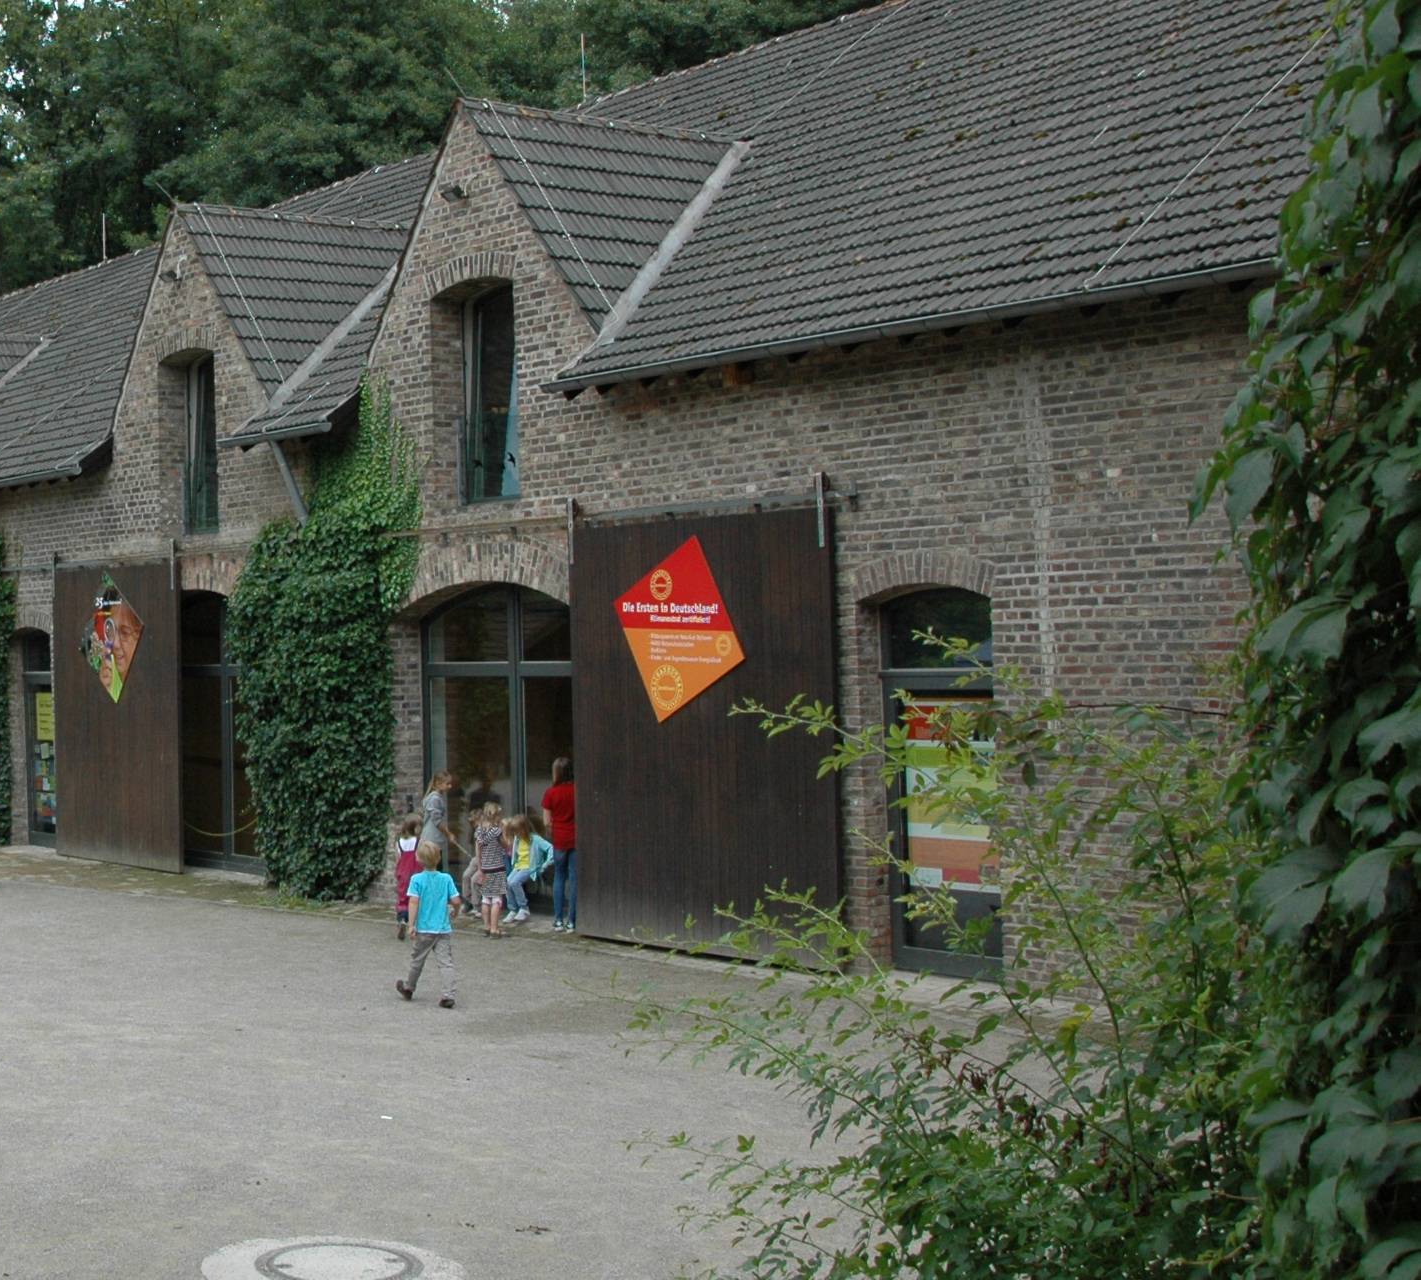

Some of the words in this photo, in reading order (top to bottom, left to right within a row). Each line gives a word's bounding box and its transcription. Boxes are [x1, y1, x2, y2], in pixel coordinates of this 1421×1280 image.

[622, 602, 635, 613] Die
[636, 602, 659, 613] Ersten
[660, 602, 669, 613] in
[670, 602, 719, 614] Deutschland!
